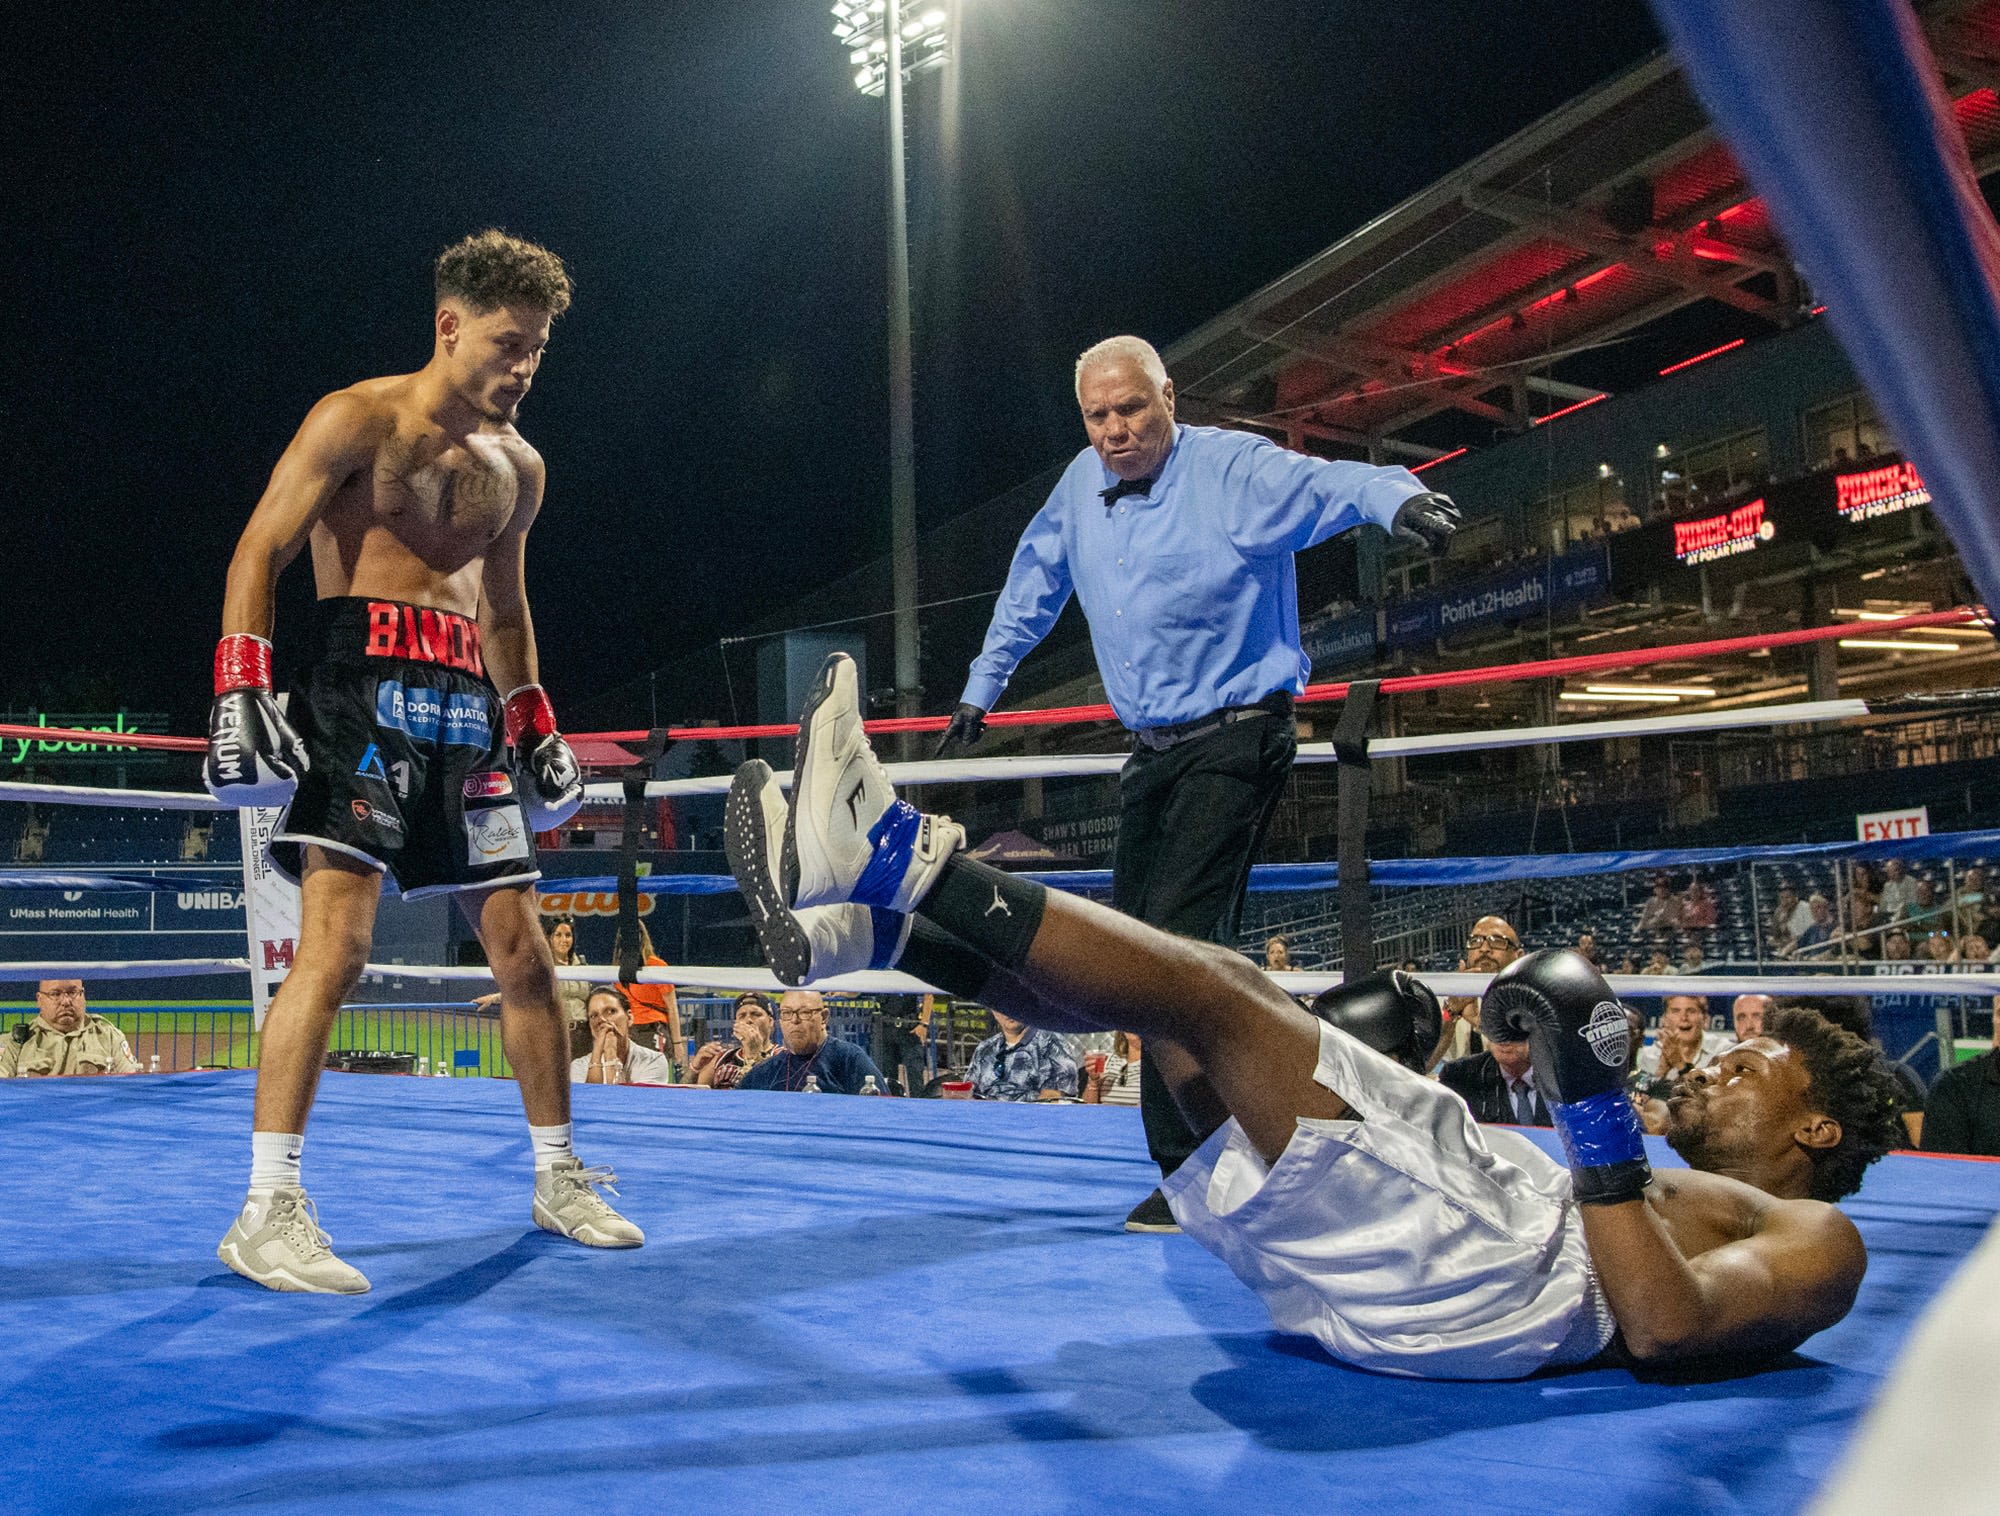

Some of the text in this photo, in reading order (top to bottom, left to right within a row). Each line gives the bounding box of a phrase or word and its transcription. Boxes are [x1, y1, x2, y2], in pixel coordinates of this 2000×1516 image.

[1866, 499, 1904, 519] POLAR
[1699, 545, 1730, 562] POLAR
[1731, 539, 1756, 555] PARK
[407, 715, 436, 724] CREDIT
[0, 713, 138, 763] ybank
[213, 694, 243, 780] VENUM
[1863, 817, 1921, 842] EXIT
[250, 828, 261, 881] BUILDINGS
[10, 907, 139, 918] UMass Memorial Health
[178, 892, 246, 910] UNIBA
